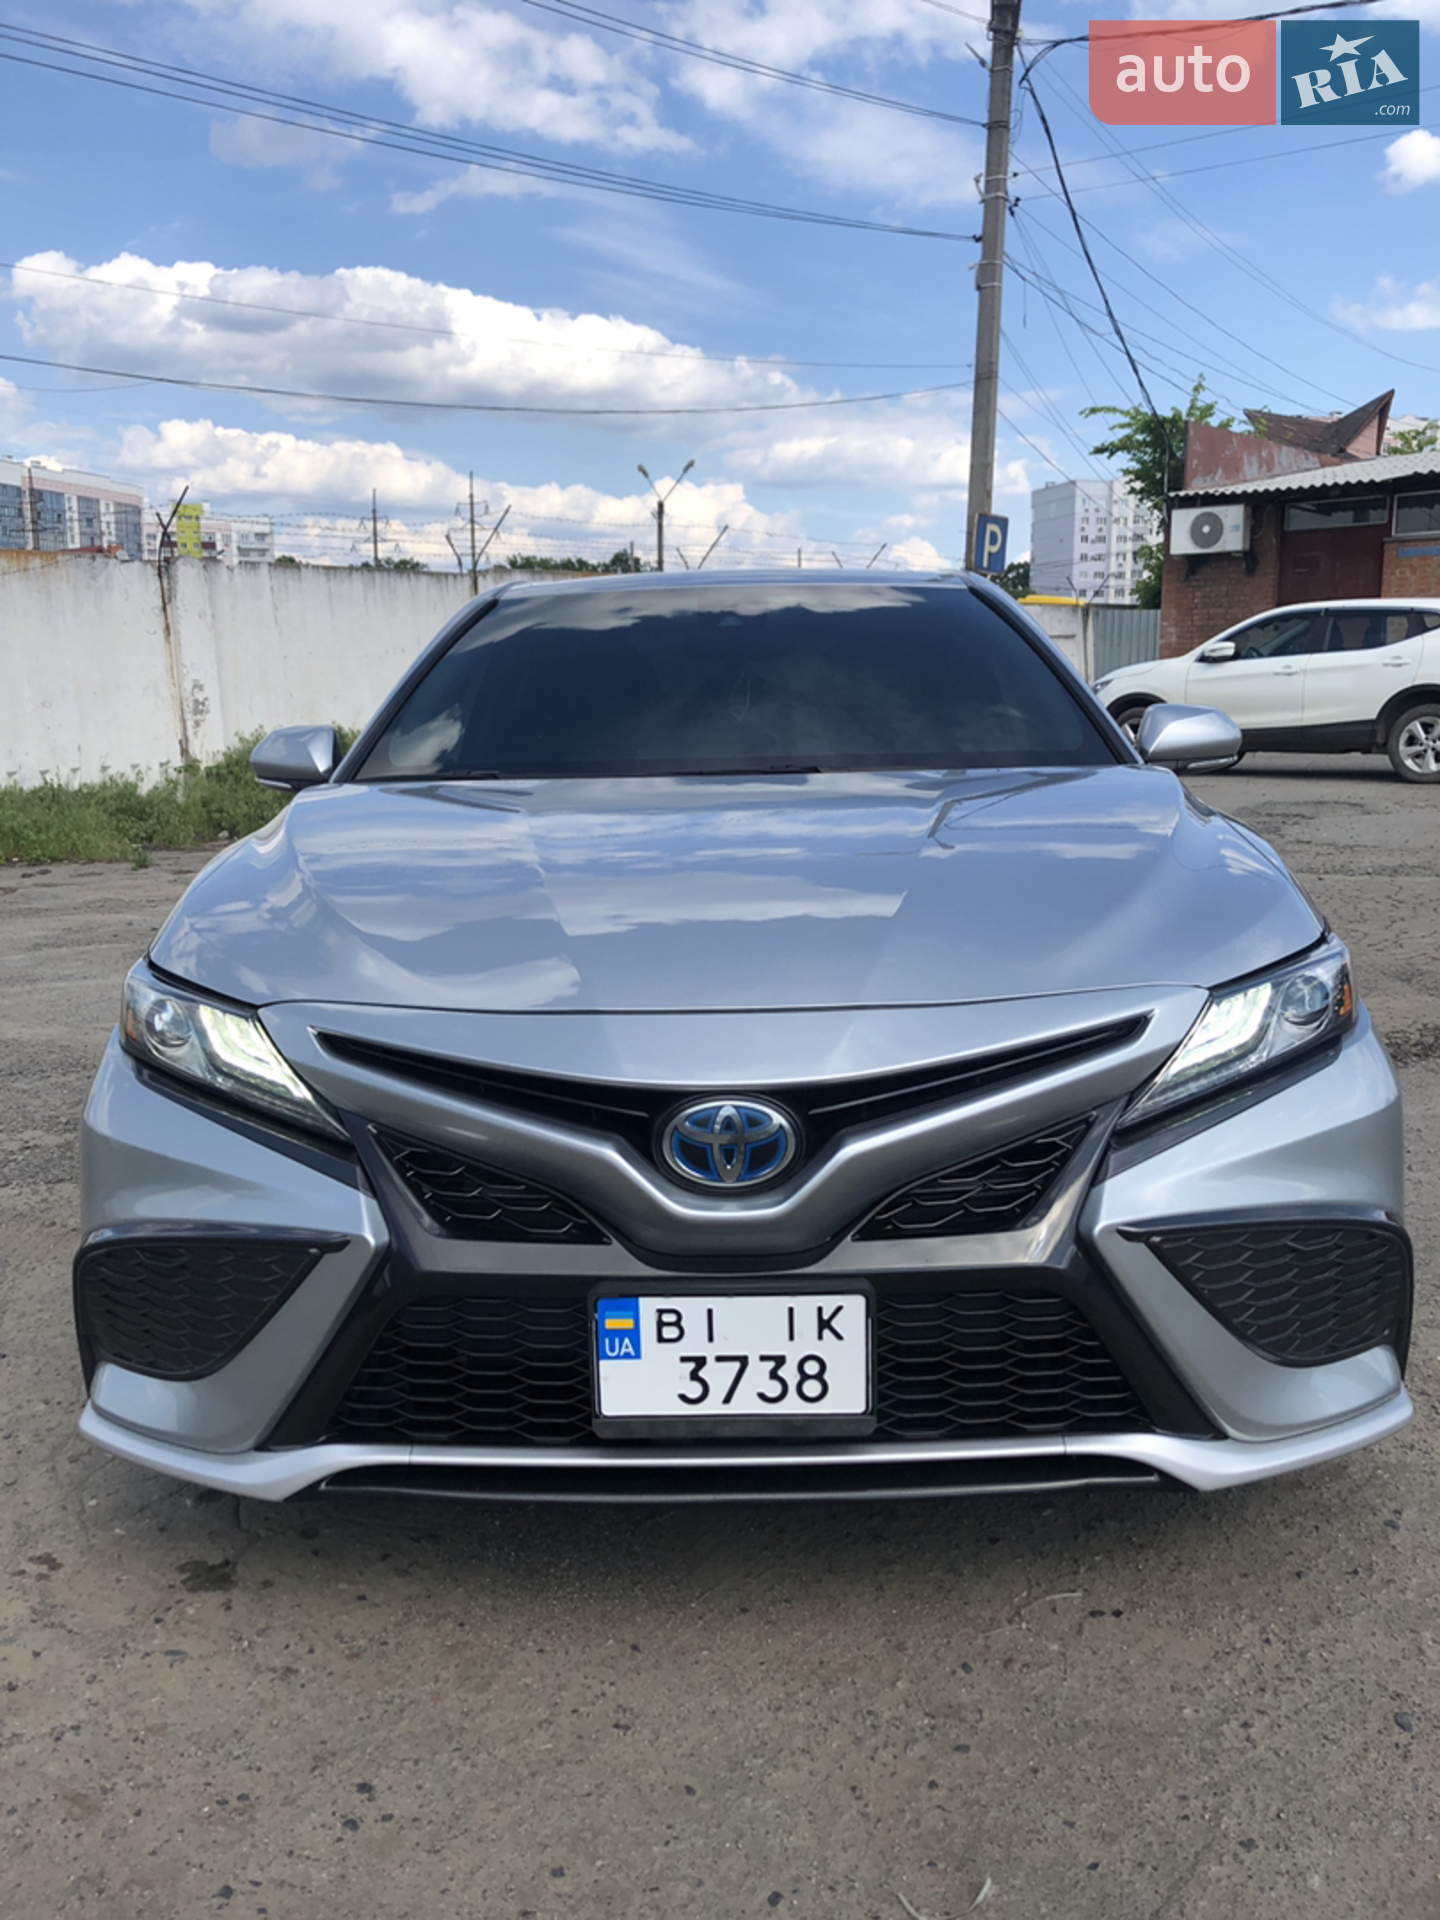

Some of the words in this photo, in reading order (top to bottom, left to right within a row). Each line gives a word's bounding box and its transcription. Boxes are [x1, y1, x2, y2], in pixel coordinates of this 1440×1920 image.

[983, 523, 1002, 568] P
[656, 1308, 714, 1344] BI
[787, 1305, 844, 1342] IK
[604, 1337, 636, 1357] UA
[677, 1354, 829, 1406] 3738
